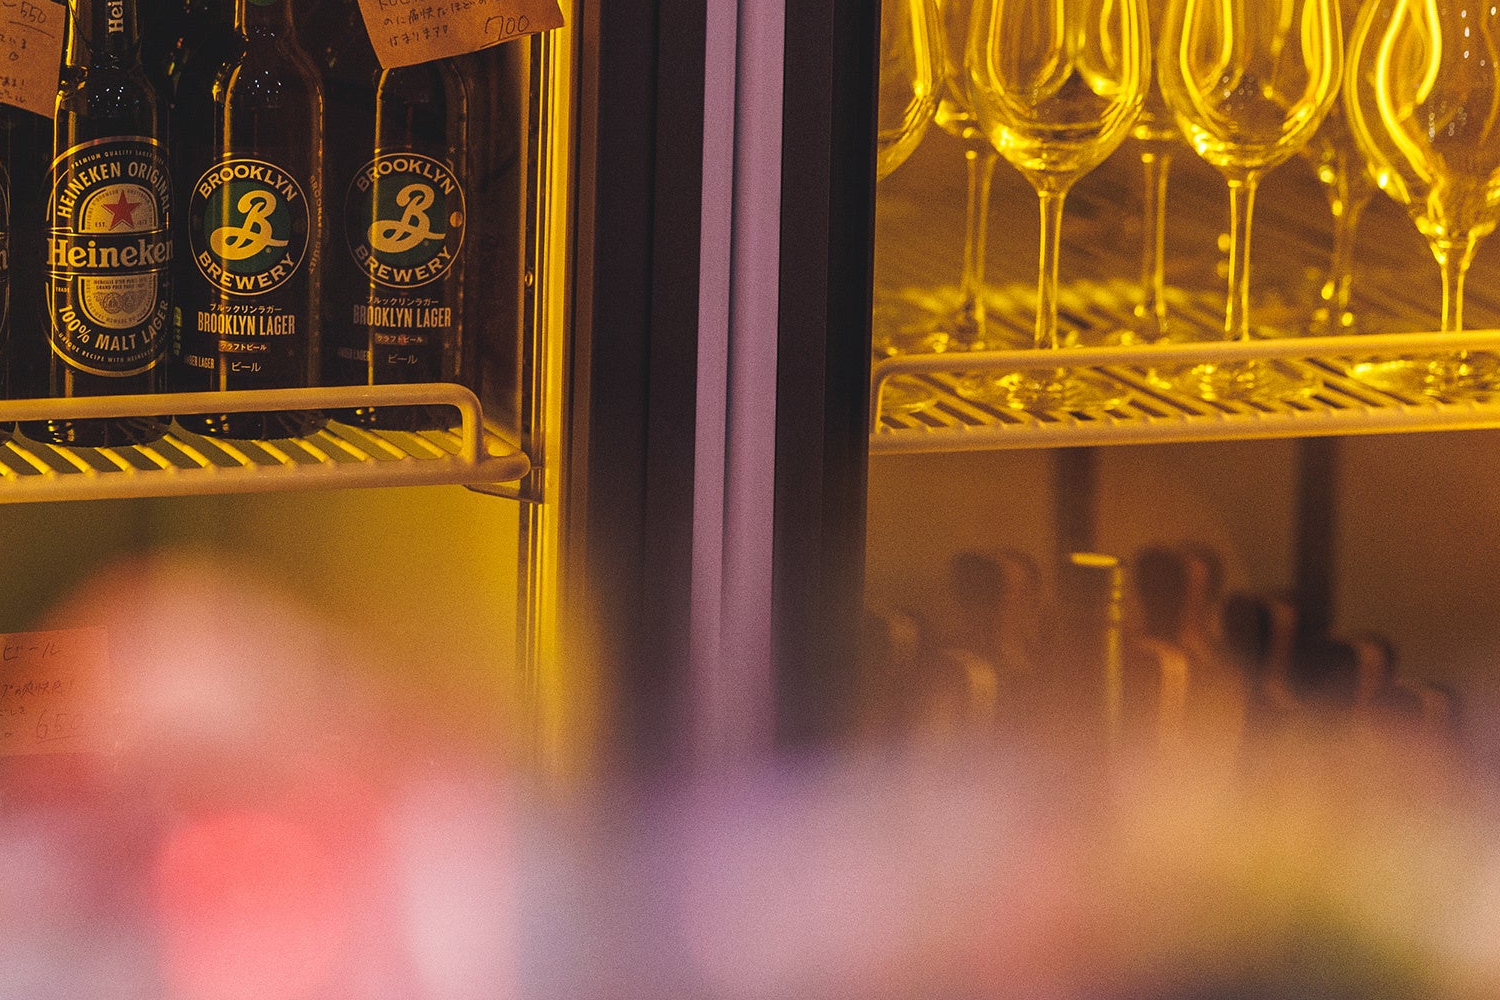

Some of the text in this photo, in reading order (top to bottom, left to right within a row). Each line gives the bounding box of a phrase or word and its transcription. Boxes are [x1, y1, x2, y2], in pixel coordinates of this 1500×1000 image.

[484, 14, 531, 43] 700
[71, 153, 101, 170] PREMIUM
[57, 161, 121, 219] HEINEKEN
[127, 161, 171, 215] ORIGINAL
[199, 164, 299, 203] BROOKLYN
[356, 158, 457, 198] BROOKLYN
[45, 237, 174, 270] Heineken
[355, 245, 453, 284] BREWERY
[197, 250, 297, 291] BREWERY
[209, 303, 283, 314] ブルックリンラガー
[353, 304, 452, 328] BROOKLYN LAGER
[58, 300, 169, 352] 100% MALT LAGER
[197, 311, 296, 336] BROOKLYN LAGER
[81, 350, 105, 363] RECIPE
[220, 342, 268, 352] クラフトビール
[388, 354, 419, 365] ビール
[198, 357, 215, 369] LAGER
[231, 361, 262, 372] ビール
